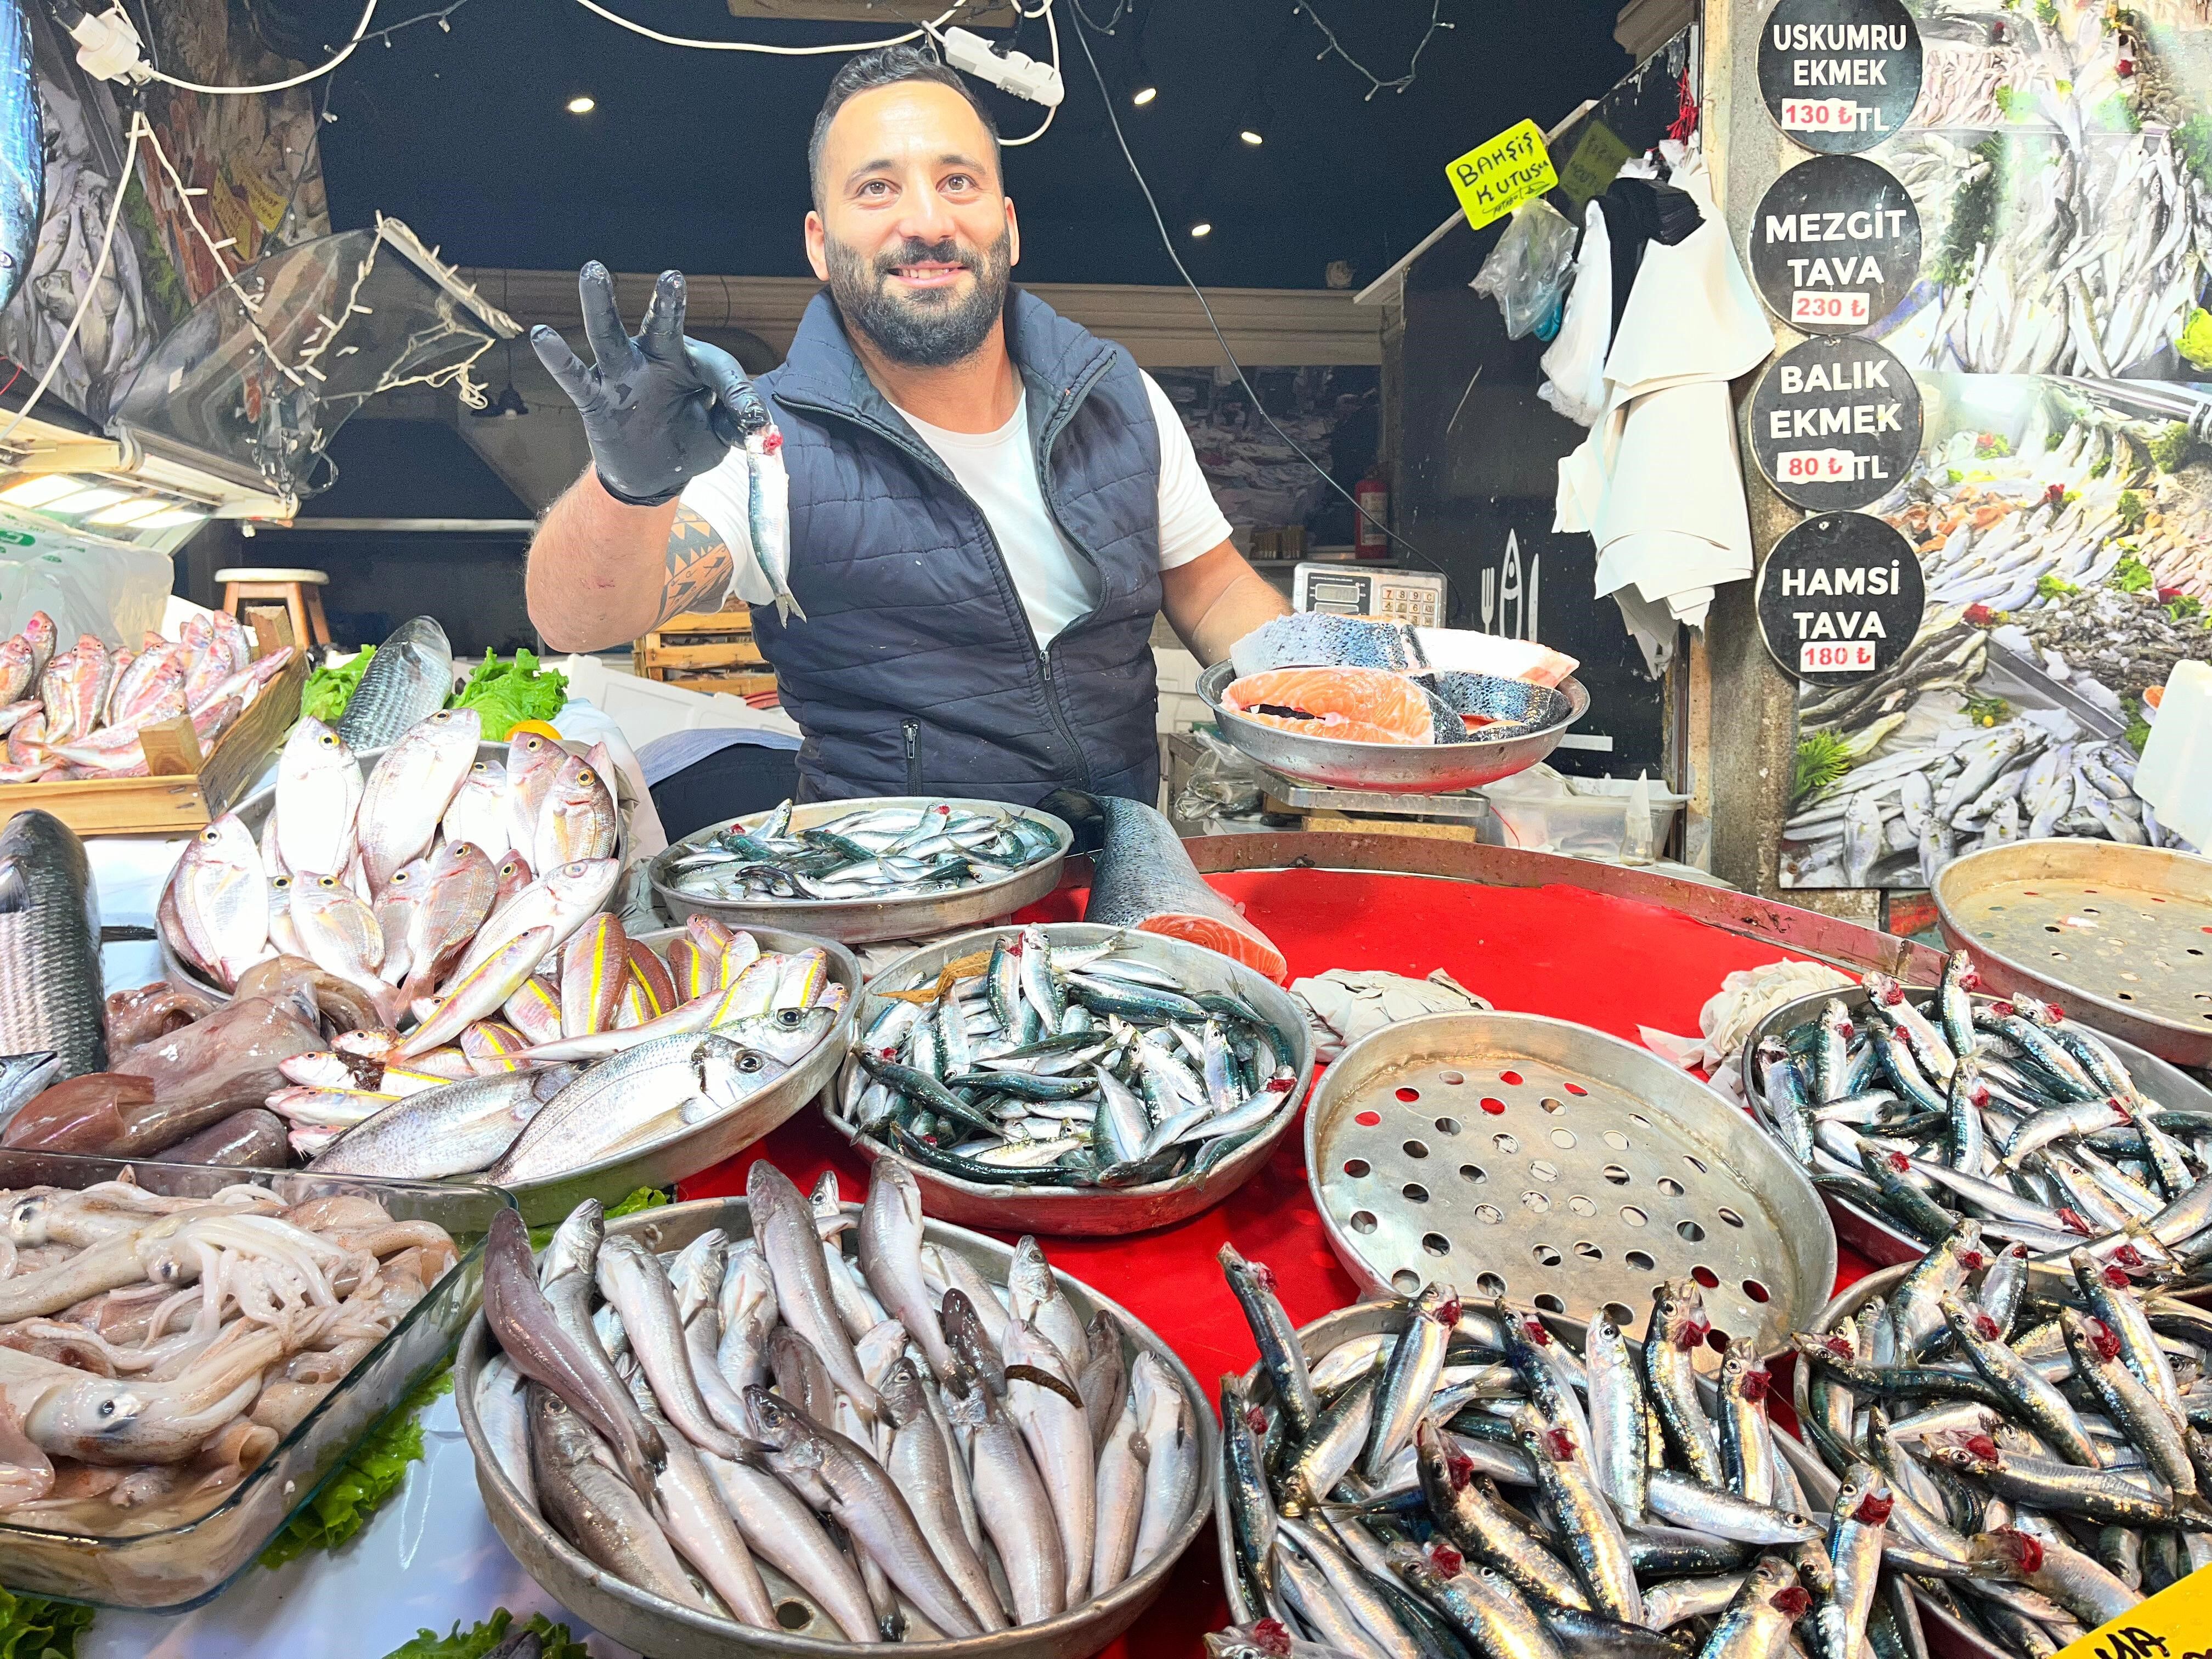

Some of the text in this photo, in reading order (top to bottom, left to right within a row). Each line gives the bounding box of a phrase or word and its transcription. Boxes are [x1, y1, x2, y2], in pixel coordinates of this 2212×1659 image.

[1773, 24, 1906, 51] USKUMRU
[1794, 59, 1887, 86] EKMEK
[1786, 105, 1830, 124] 130
[1857, 108, 1890, 132] TL
[1765, 203, 1907, 244] MEZGİT
[1787, 256, 1885, 287] TAVA
[1796, 298, 1842, 317] 230
[1780, 359, 1890, 394] BALIK
[1770, 403, 1902, 439] EKMEK
[1789, 458, 1819, 476] 80
[1854, 455, 1888, 480] TL
[1782, 559, 1900, 596] HAMSİ
[1792, 611, 1887, 639] TAVA
[1804, 647, 1848, 665] 180
